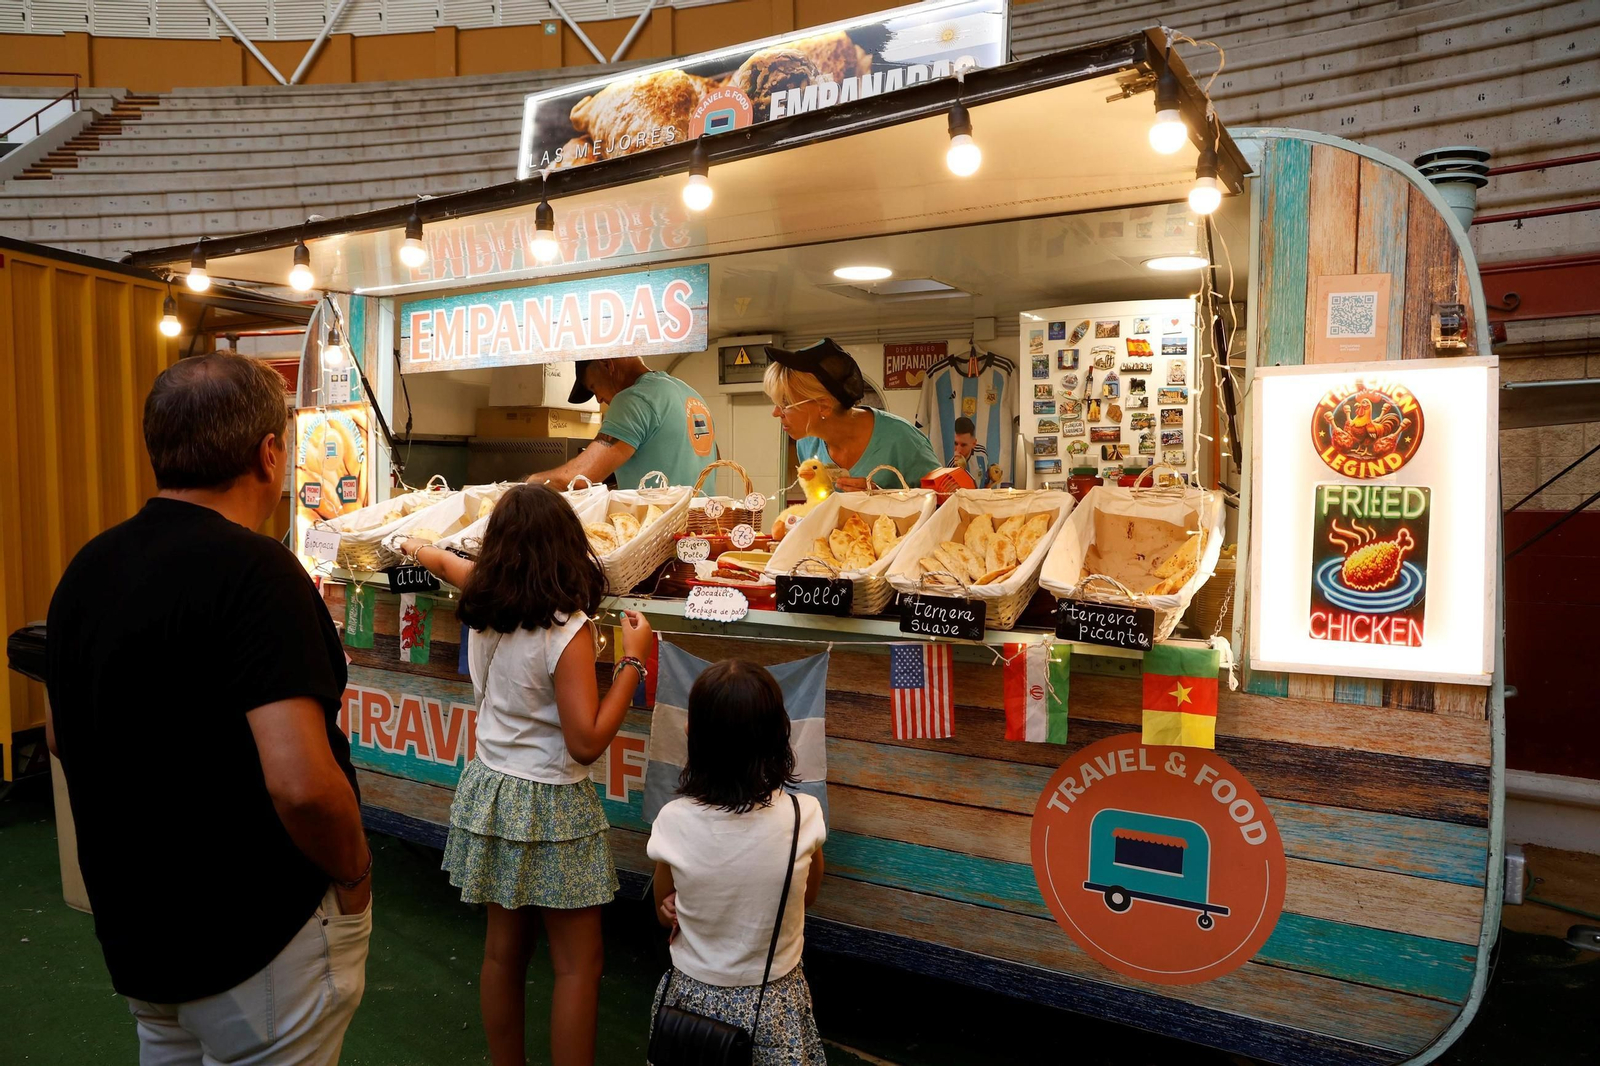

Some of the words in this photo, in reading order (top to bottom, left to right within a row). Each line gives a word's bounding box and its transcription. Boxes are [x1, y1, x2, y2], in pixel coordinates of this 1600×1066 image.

[694, 91, 723, 121] TRAVEL
[724, 90, 731, 98] &
[732, 90, 749, 111] FOOD
[528, 148, 564, 168] LAS
[575, 125, 677, 158] MEJORES
[409, 279, 694, 363] EMPANADAS
[1320, 445, 1403, 478] LEGIND
[704, 597, 713, 605] de
[787, 584, 840, 606] Pollo
[1079, 623, 1147, 645] picante
[1309, 611, 1425, 646] CHICKEN
[1046, 748, 1156, 814] TRAVEL
[1164, 751, 1188, 778] &
[1193, 763, 1268, 846] FOOD
